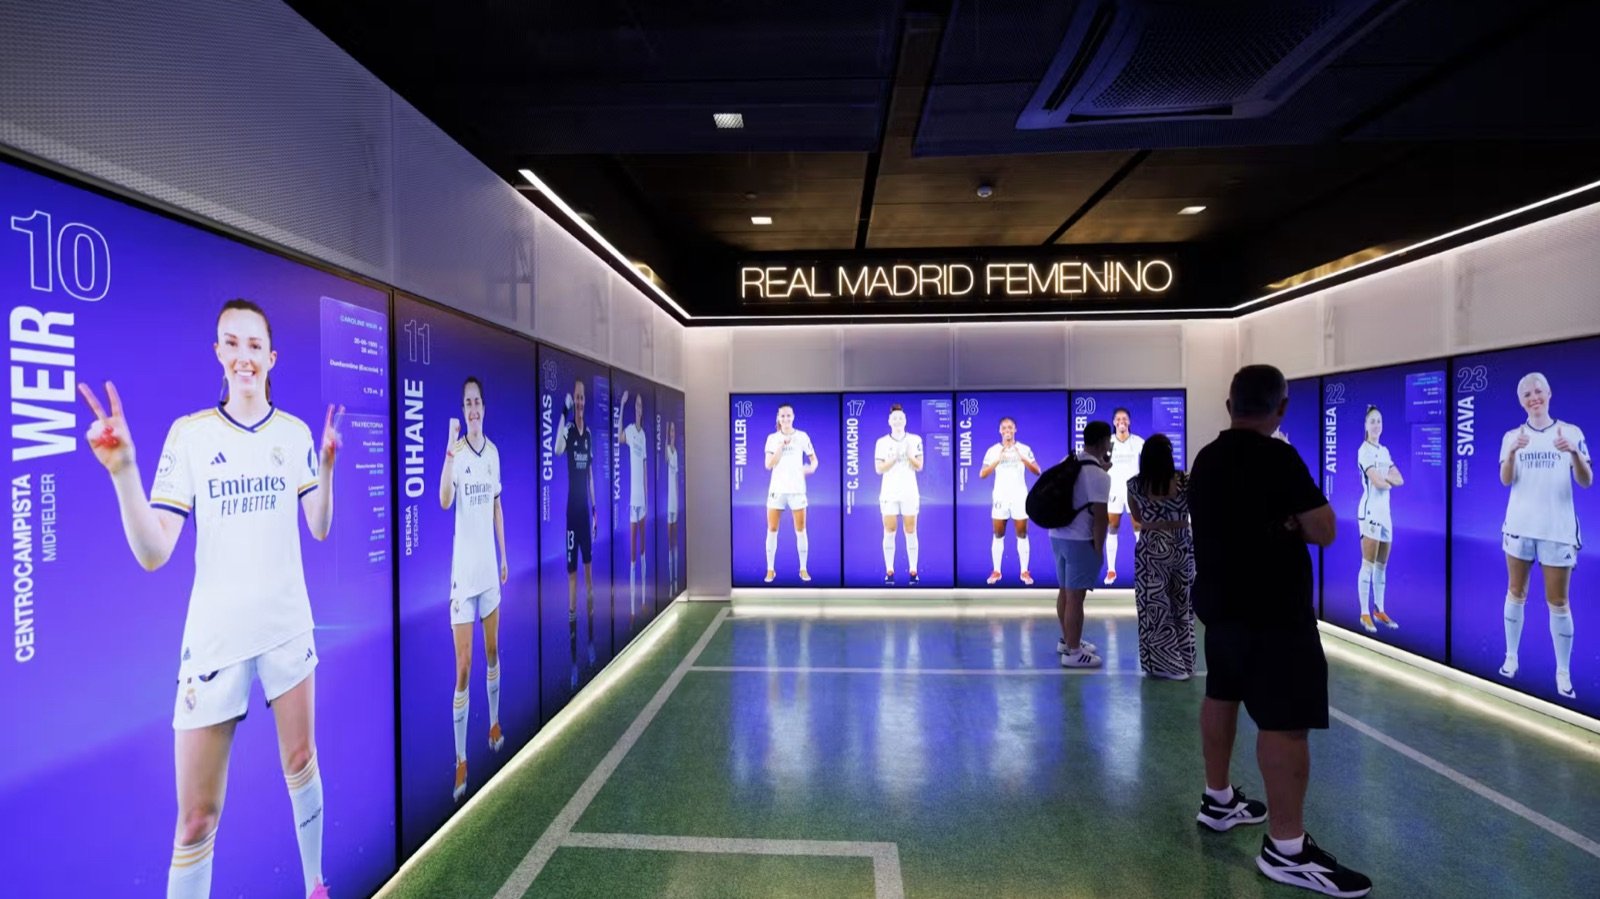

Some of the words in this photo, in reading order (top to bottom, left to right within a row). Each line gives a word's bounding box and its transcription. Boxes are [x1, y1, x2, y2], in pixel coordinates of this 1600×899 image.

[10, 209, 111, 302] 10
[741, 266, 831, 298] REAL
[838, 264, 974, 297] MADRID
[986, 259, 1173, 295] FEMENINO
[404, 319, 430, 365] 11
[9, 305, 77, 462] WEIR
[543, 360, 558, 391] 13
[1457, 365, 1488, 393] 23
[735, 400, 753, 418] 16
[847, 400, 865, 416] 17
[960, 398, 979, 415] 18
[1075, 397, 1096, 414] 20
[1326, 382, 1346, 405] 22
[404, 378, 425, 498] OIHANE
[543, 394, 553, 481] CHAVAS
[960, 417, 972, 429] C.
[1325, 407, 1337, 473] ATHENEA
[1457, 396, 1475, 456] SVAVA
[735, 419, 747, 466] MØLLER
[846, 418, 859, 475] CAMACHO
[960, 431, 972, 466] LINDA
[207, 474, 286, 499] Emirates
[846, 478, 859, 489] C.
[41, 473, 57, 562] MIDFIELDER
[221, 499, 239, 517] FLY
[241, 494, 277, 514] BETTER
[567, 530, 575, 550] 13
[12, 473, 35, 663] CENTROCAMPISTA
